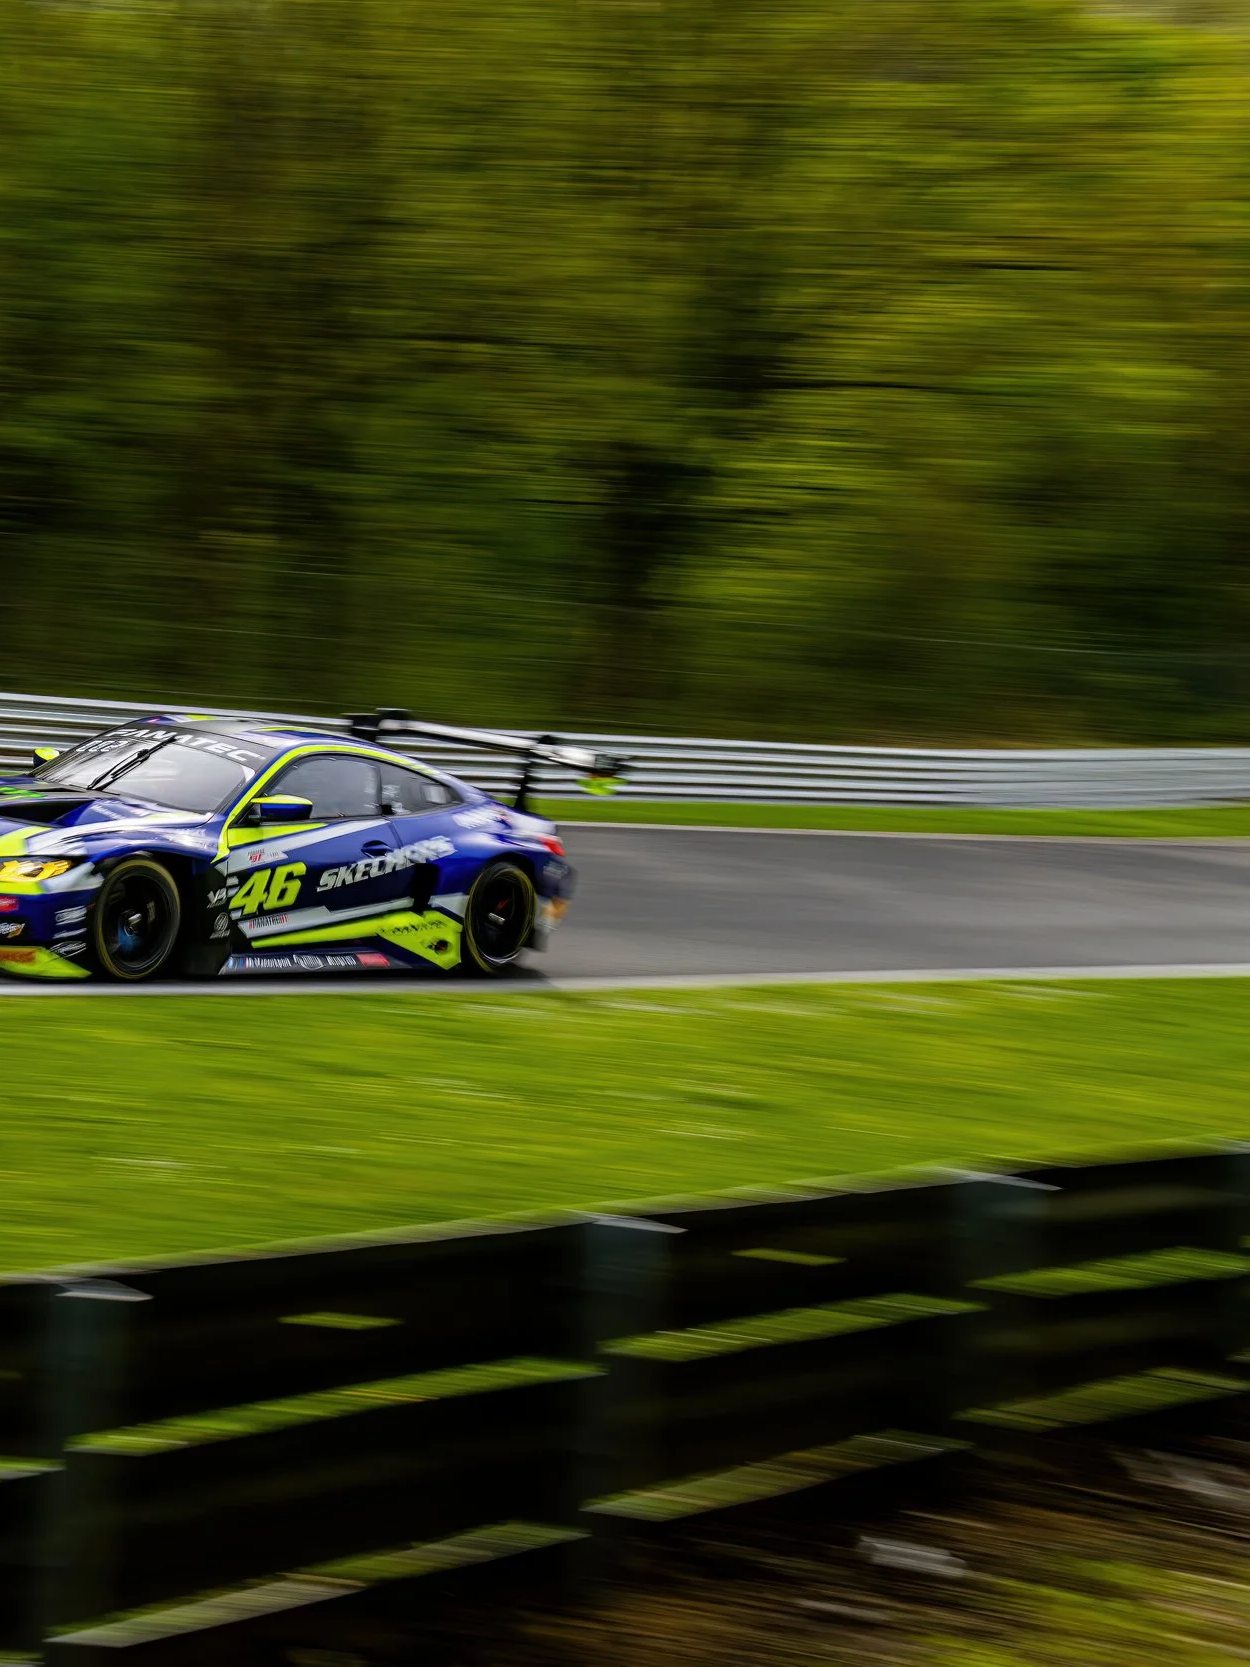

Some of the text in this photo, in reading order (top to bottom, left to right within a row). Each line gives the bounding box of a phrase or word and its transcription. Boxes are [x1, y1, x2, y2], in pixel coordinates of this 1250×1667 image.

[106, 728, 260, 761] FANATEC
[229, 861, 307, 916] 46
[317, 835, 457, 892] SKECH
